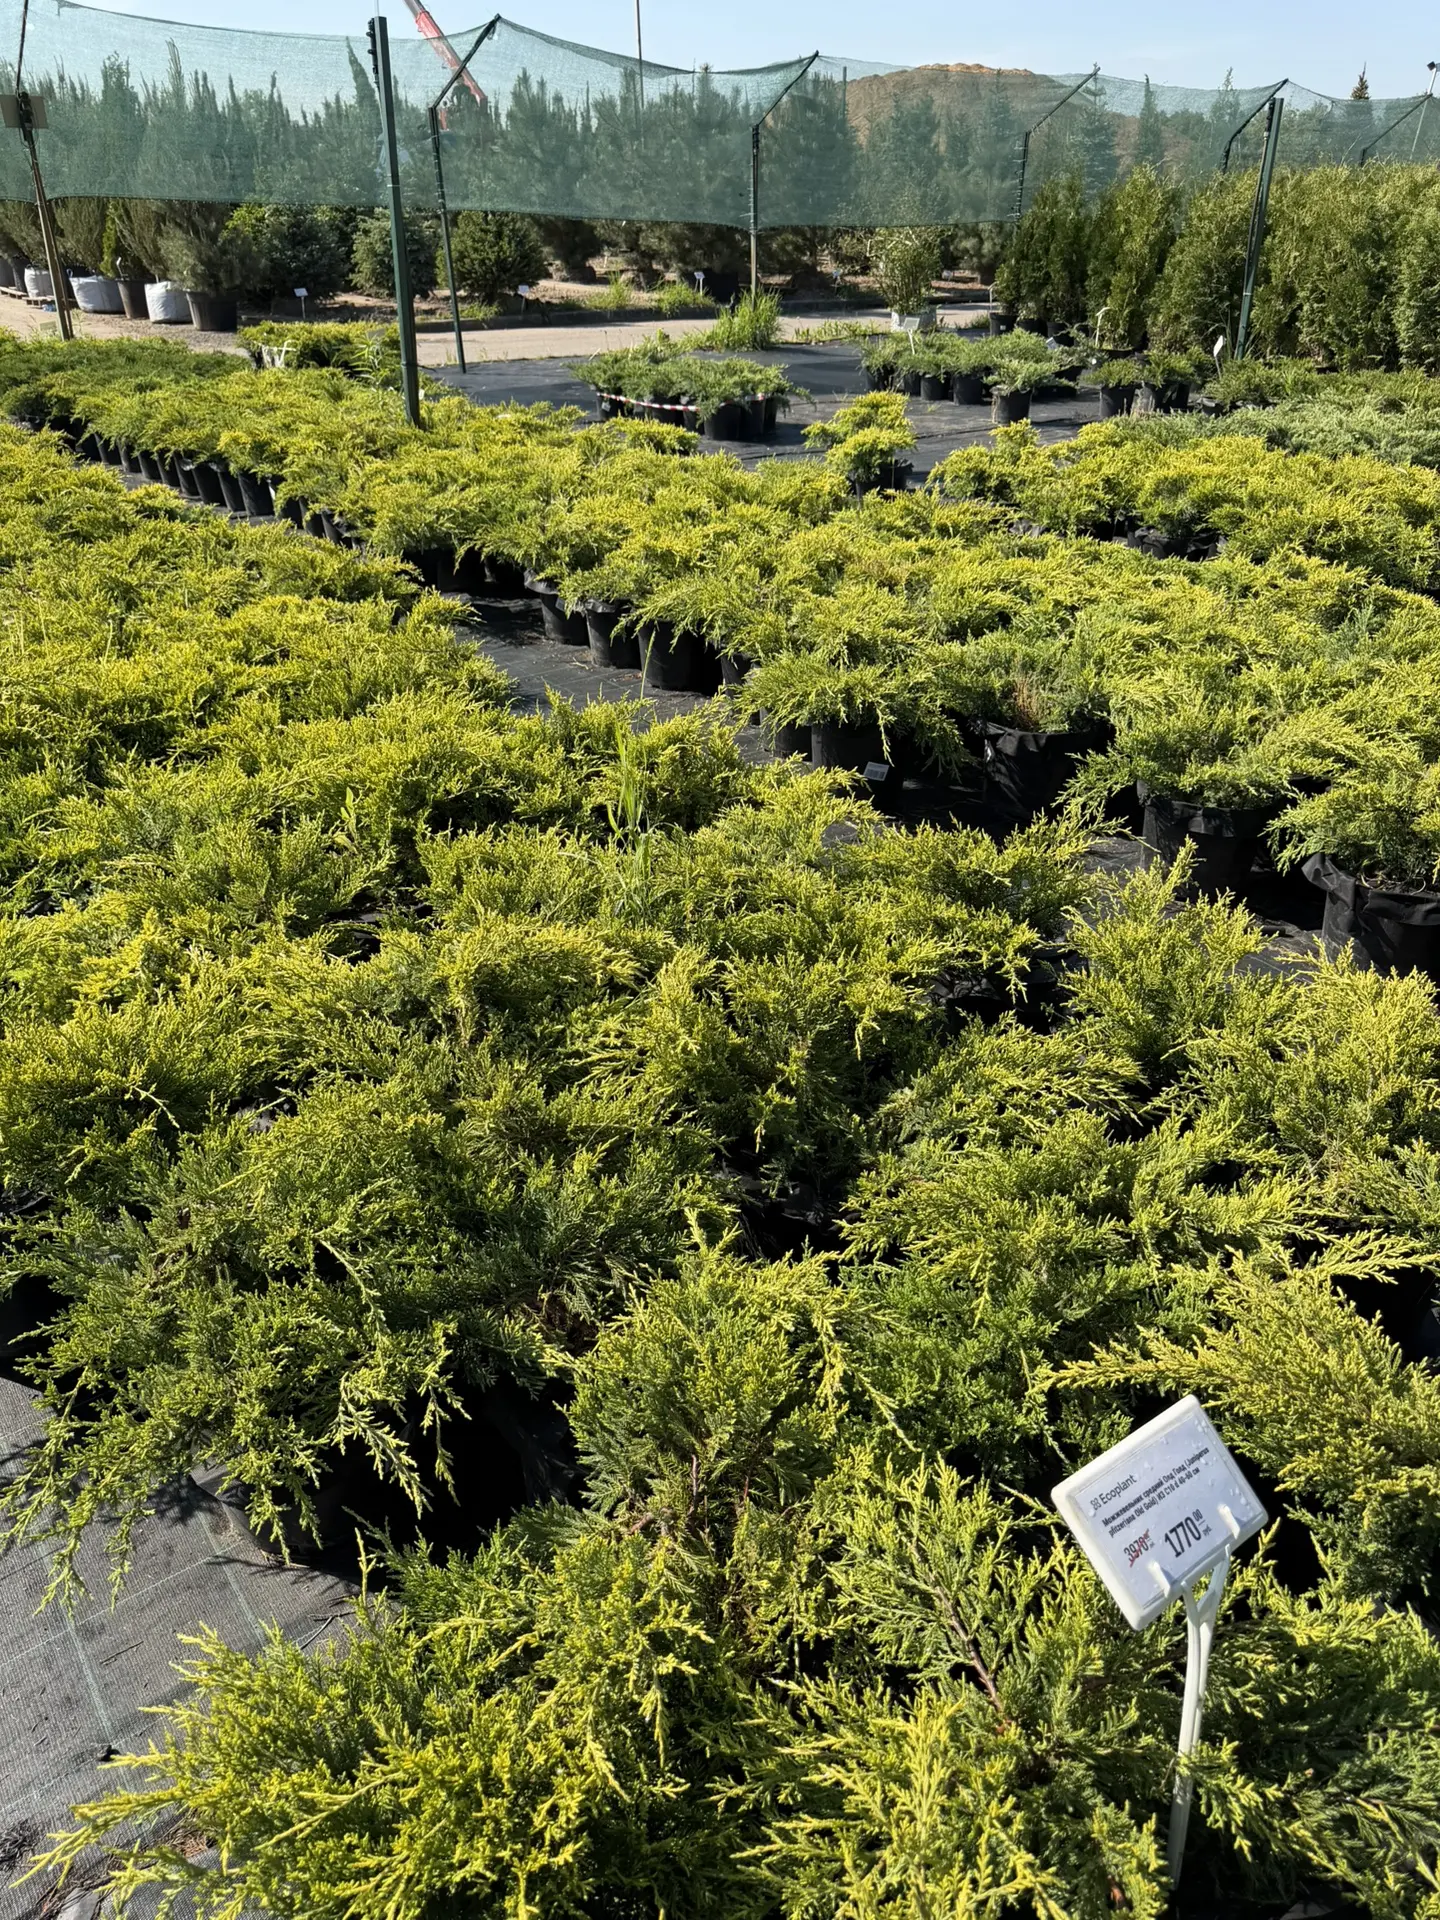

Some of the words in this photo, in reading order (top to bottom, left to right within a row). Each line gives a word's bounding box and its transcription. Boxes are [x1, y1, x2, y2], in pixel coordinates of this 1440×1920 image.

[1098, 1474, 1137, 1505] Ecoplant
[1101, 1494, 1144, 1527] Можжевельник
[1142, 1478, 1164, 1497] средний
[1162, 1472, 1175, 1483] Олд
[1171, 1464, 1187, 1476] Голд
[1134, 1505, 1145, 1517] Old
[1143, 1496, 1158, 1511] Gold)
[1123, 1536, 1149, 1562] 3970
[1165, 1516, 1202, 1558] 1770
